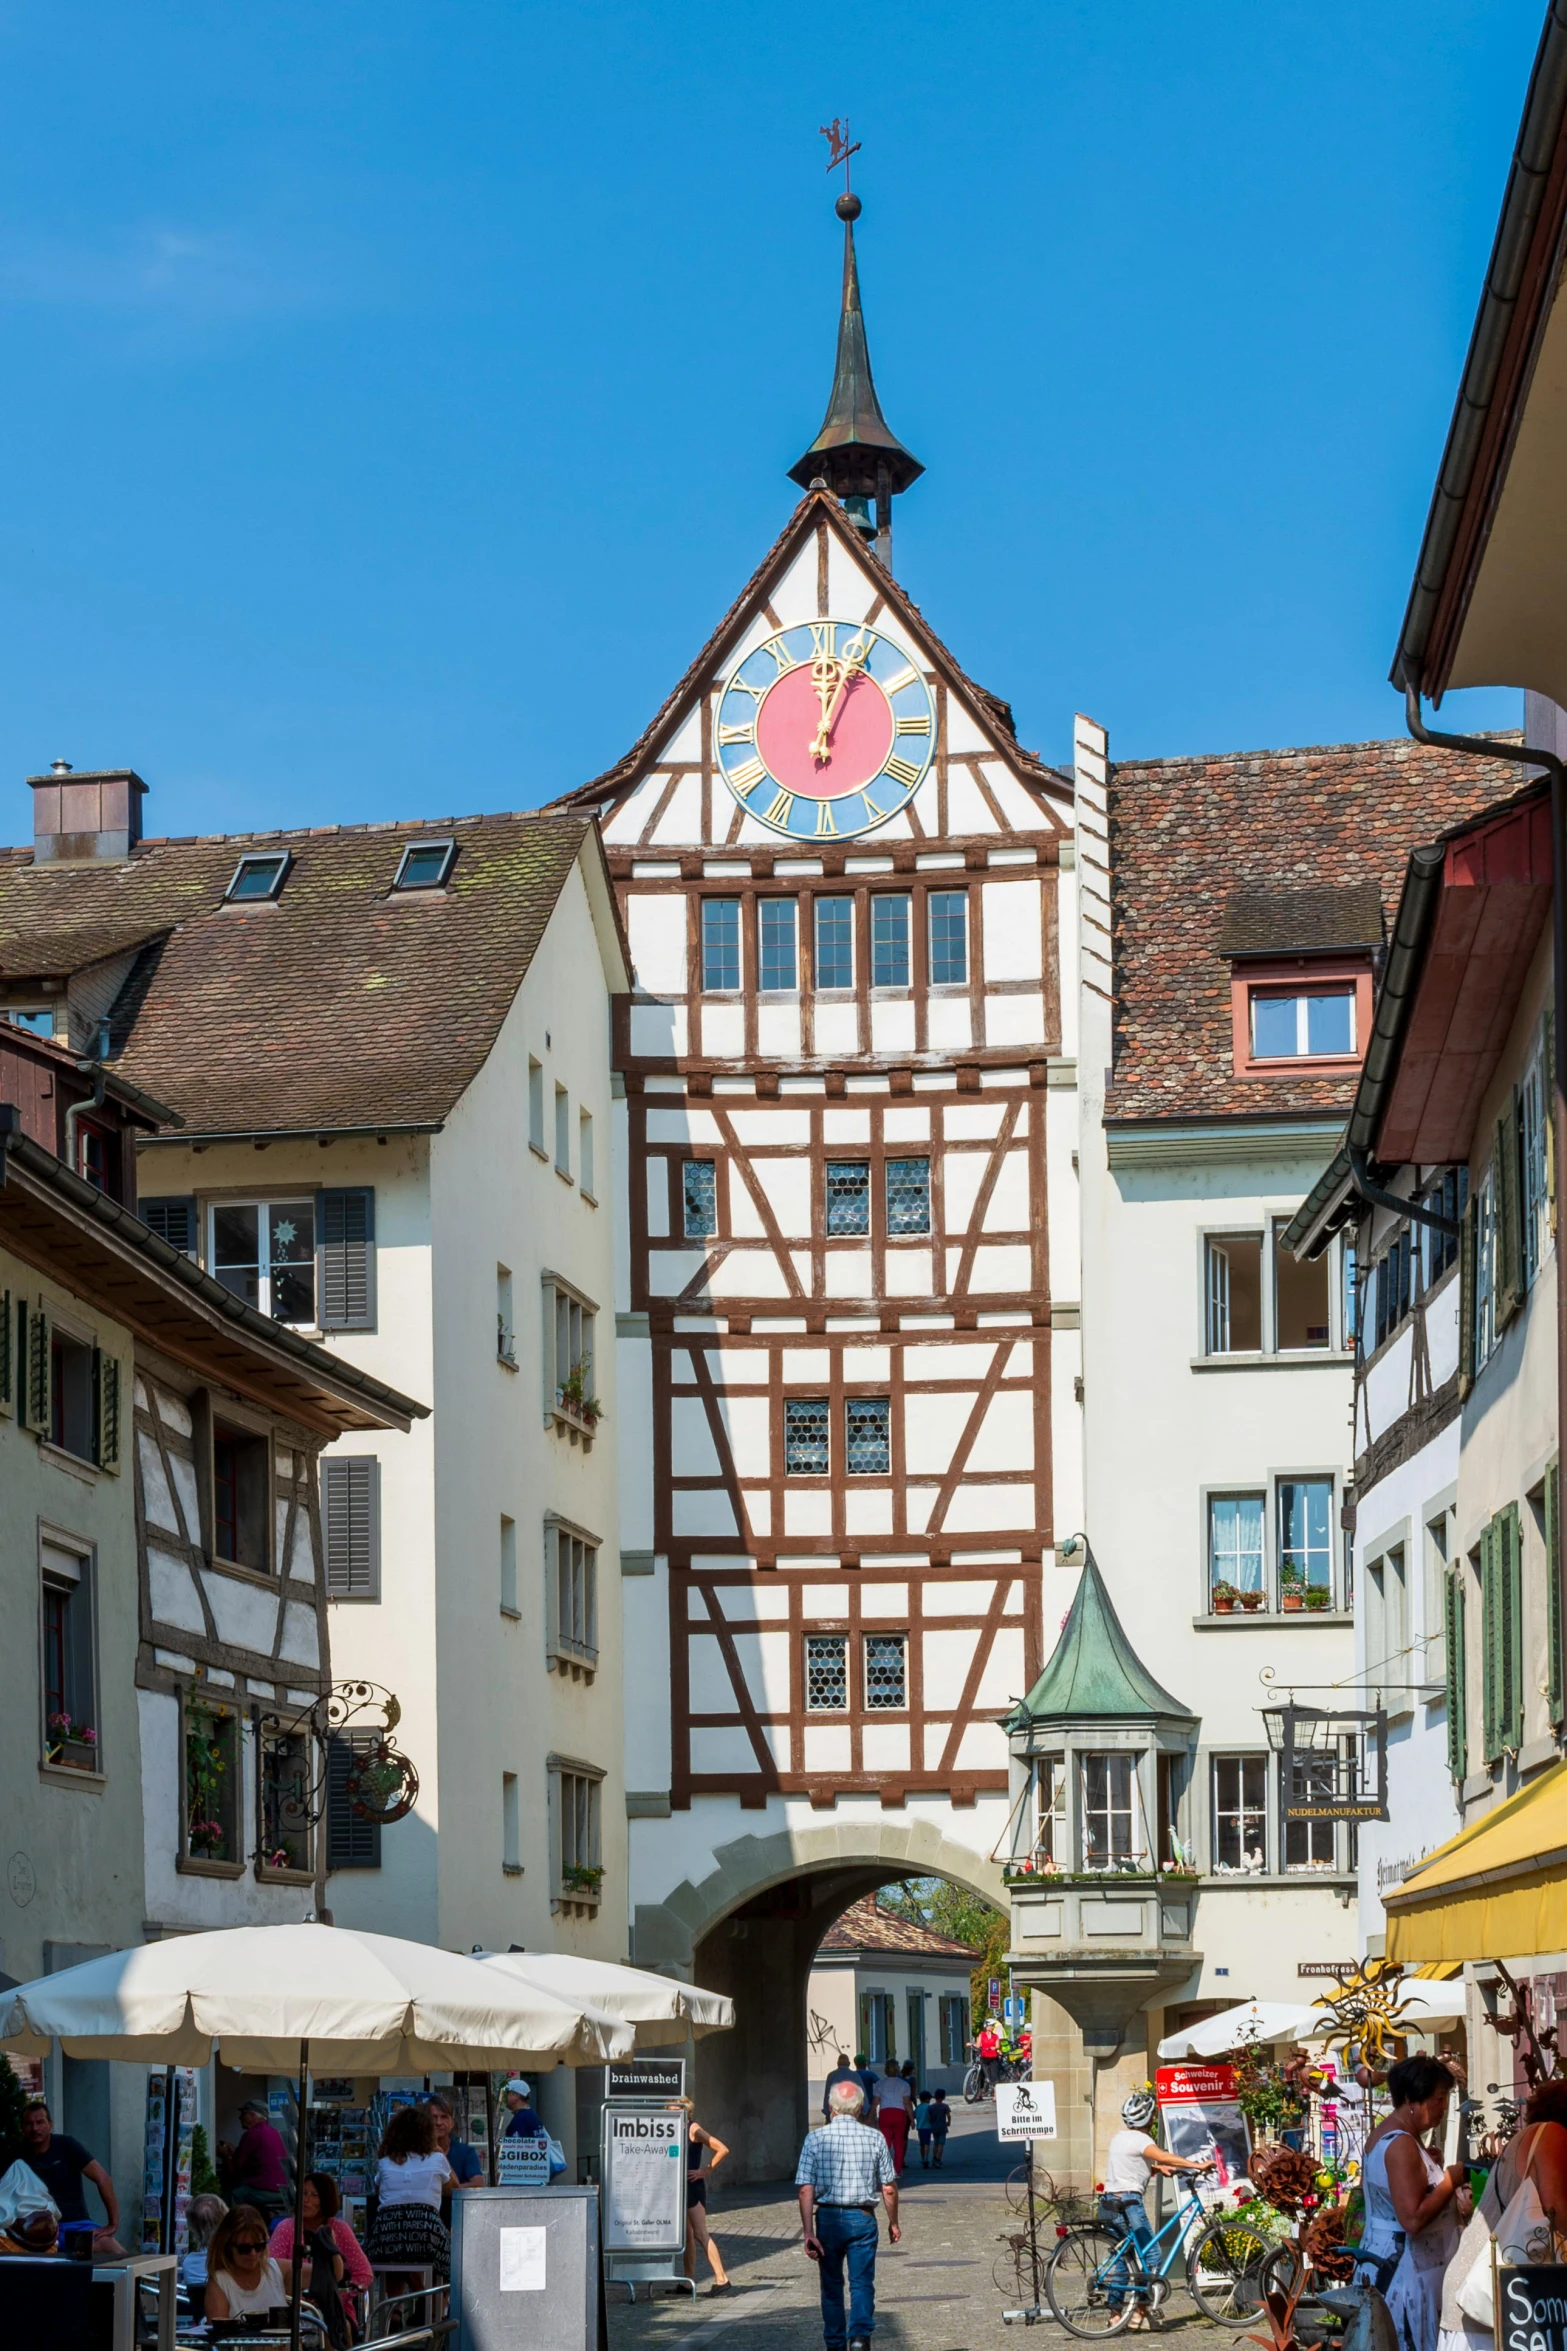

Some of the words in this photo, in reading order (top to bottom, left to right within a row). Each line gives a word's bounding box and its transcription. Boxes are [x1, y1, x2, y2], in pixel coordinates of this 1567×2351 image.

[729, 673, 767, 704] X
[1287, 1807, 1382, 1817] NUDELMANUFAKTUR
[611, 2072, 679, 2084] brainwashed
[1174, 2068, 1219, 2081] Schweizer
[1170, 2079, 1224, 2094] Souvenir
[1011, 2115, 1031, 2124] Bitte
[1032, 2115, 1042, 2123] im
[613, 2117, 675, 2138] Imbiss
[1001, 2126, 1054, 2136] Schritttempo
[619, 2143, 669, 2157] Take-Away
[1507, 2277, 1567, 2326] Som
